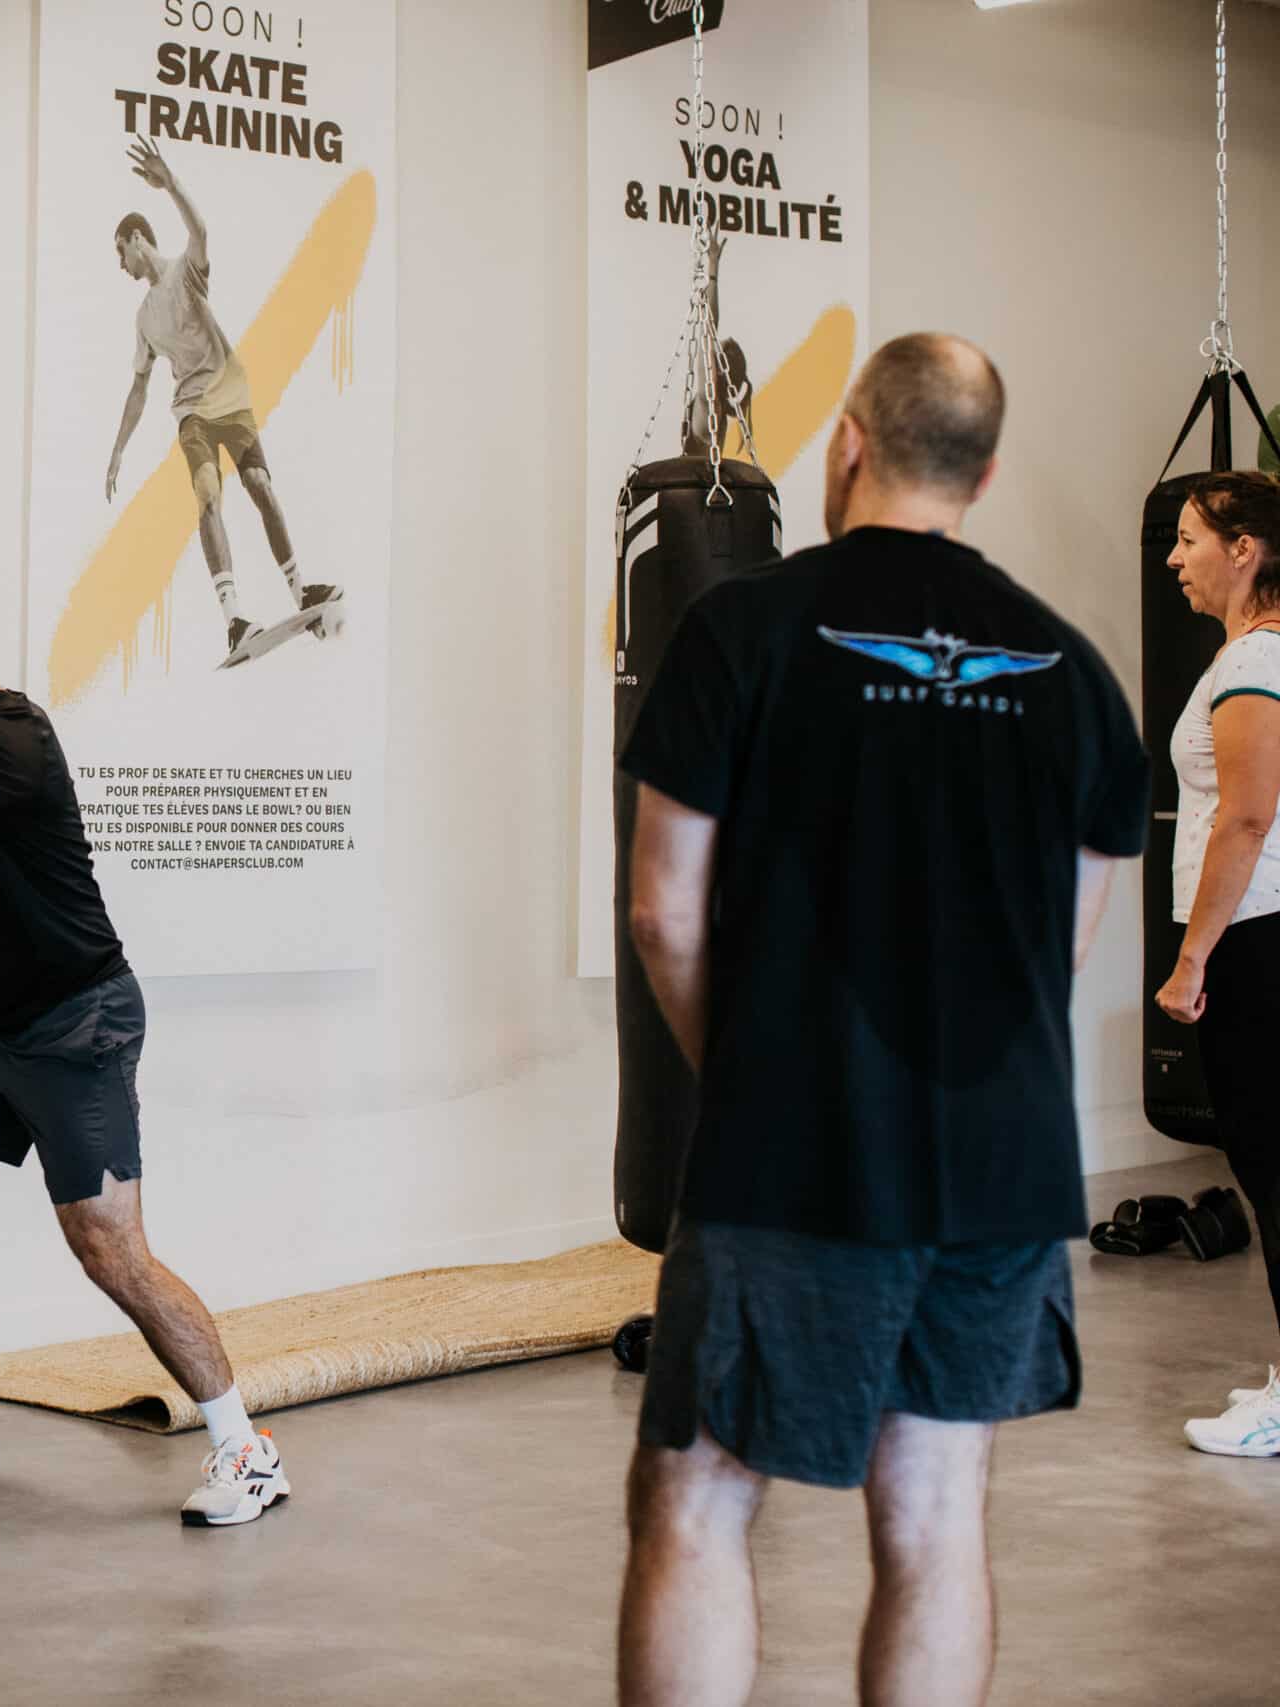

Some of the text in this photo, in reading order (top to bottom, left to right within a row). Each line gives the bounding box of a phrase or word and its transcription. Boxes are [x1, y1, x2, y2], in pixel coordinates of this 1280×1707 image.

[164, 0, 272, 42] SOON
[156, 42, 307, 106] SKATE
[115, 88, 343, 163] TRAINING
[675, 97, 760, 137] SOON
[679, 140, 781, 190] YOGA
[625, 180, 842, 242] & MOBILITÉ
[78, 768, 351, 780] TU ES PROF DE SKATE ET TU CHERCHES UN LIEU
[106, 783, 327, 800] POUR PRÉPARER PHYSIQUEMENT ET EN
[80, 801, 350, 817] PRATIQUE TES ÉLÈVES DANS LE BOWL? OU BIEN
[86, 822, 344, 833] TU ES DISPONIBLE POUR DONNER DES COURS
[95, 841, 111, 851] NS
[115, 841, 154, 851] NOTRE
[158, 840, 192, 851] SALLE
[205, 840, 246, 851] ENVOIE
[249, 840, 263, 850] TA
[266, 840, 344, 850] CANDIDATURE
[131, 857, 303, 870] CONTACT@SHAPERSCLUB.COM
